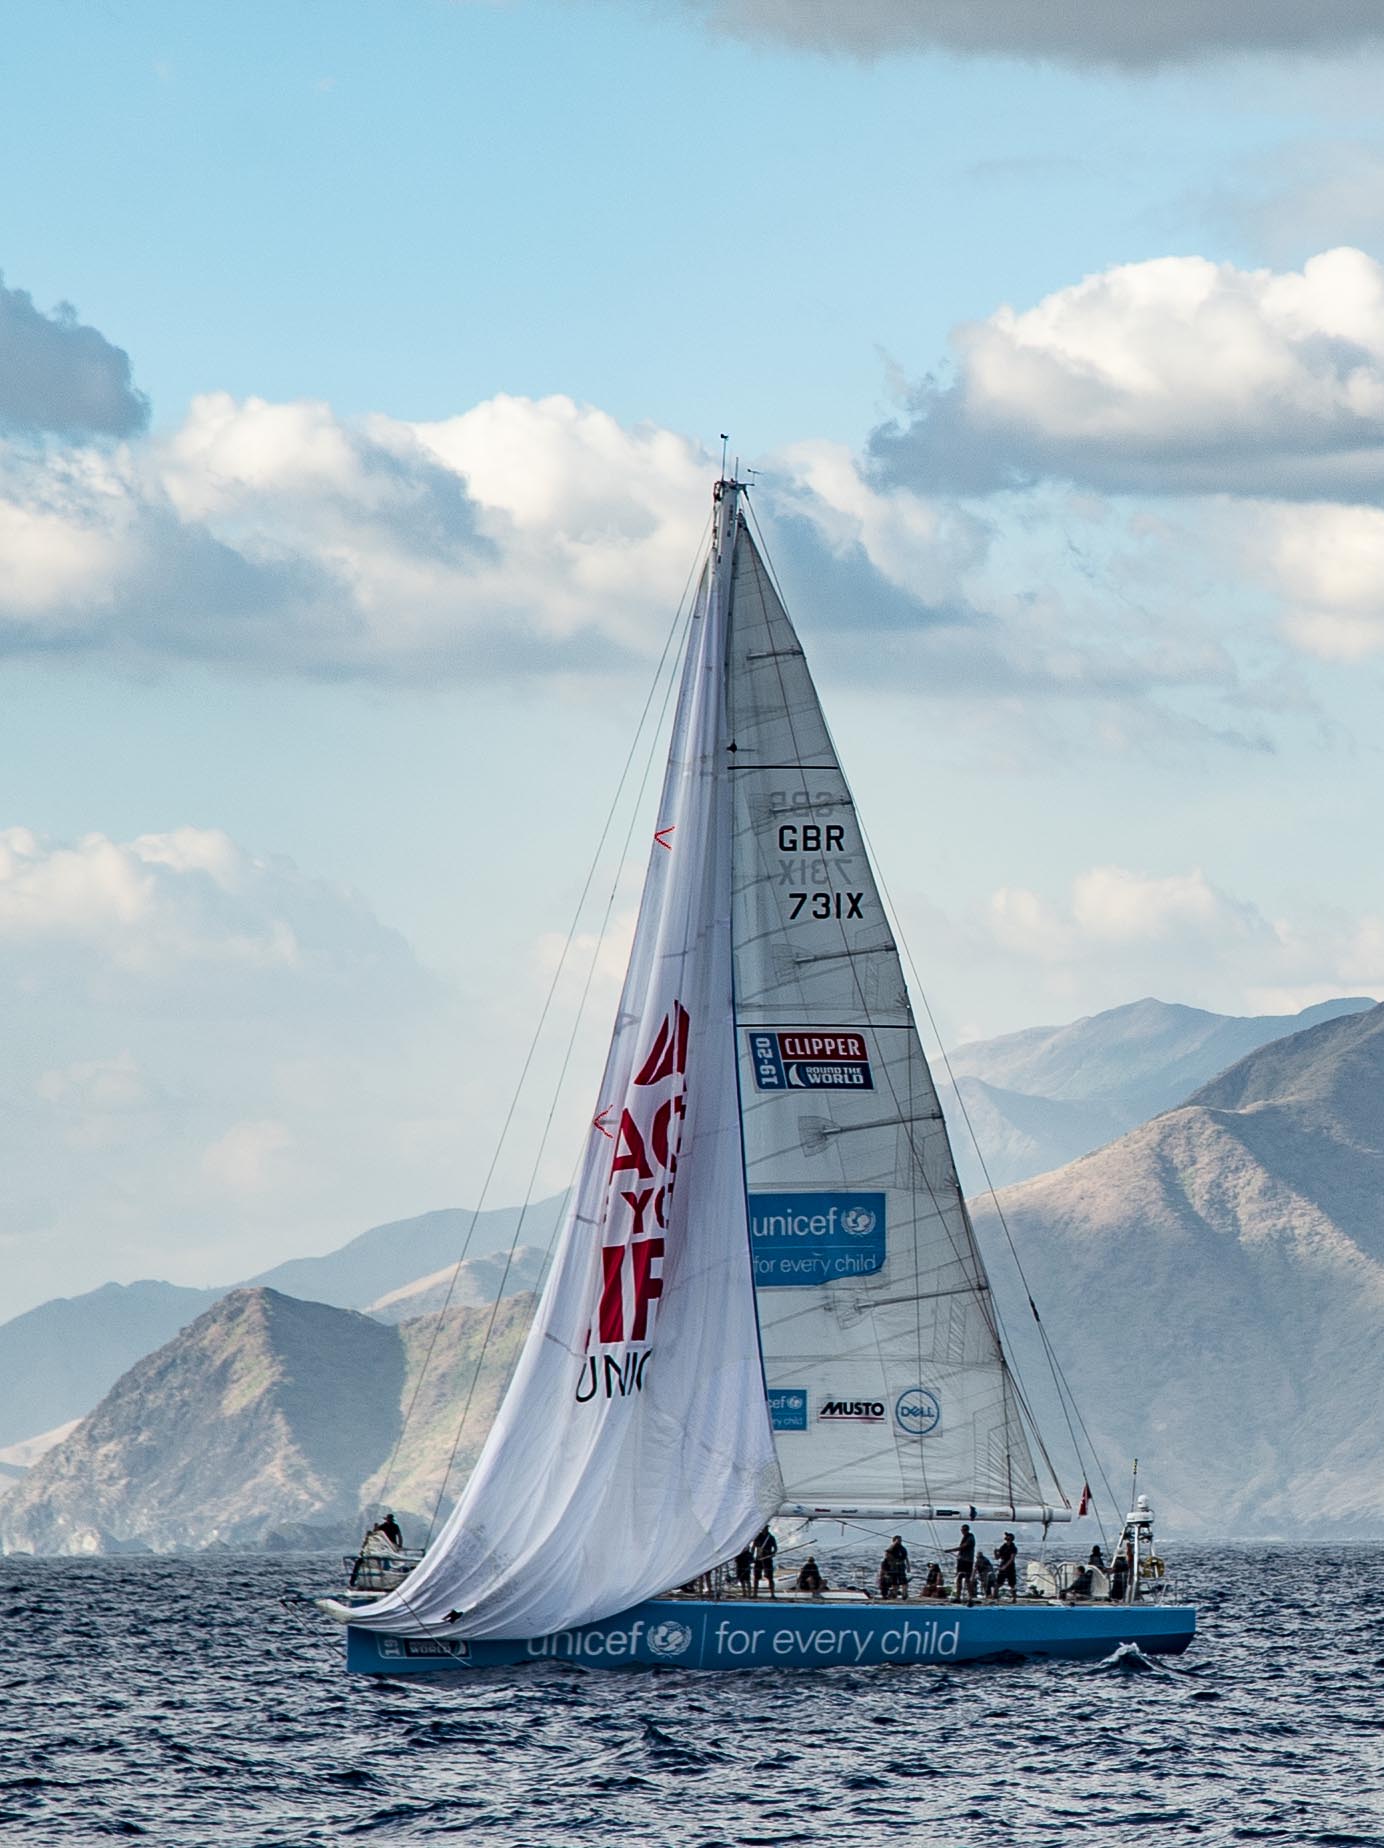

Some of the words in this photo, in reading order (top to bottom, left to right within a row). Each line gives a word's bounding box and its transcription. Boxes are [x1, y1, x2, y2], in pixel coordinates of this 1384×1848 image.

[778, 824, 845, 852] GBR
[784, 1038, 861, 1056] CLIPPER
[755, 1037, 778, 1085] 19-20
[805, 1066, 842, 1074] ROUND
[844, 1066, 862, 1074] THE
[807, 1074, 864, 1084] WORLD
[752, 1206, 838, 1237] unicef
[753, 1255, 775, 1274] for
[780, 1258, 830, 1277] every
[835, 1253, 877, 1273] child
[598, 1238, 665, 1344] IF
[820, 1401, 885, 1416] MUSTO
[901, 1406, 935, 1418] DELL
[527, 1620, 645, 1656] unicef
[716, 1620, 768, 1655] for
[772, 1629, 874, 1661] every
[880, 1620, 961, 1656] child
